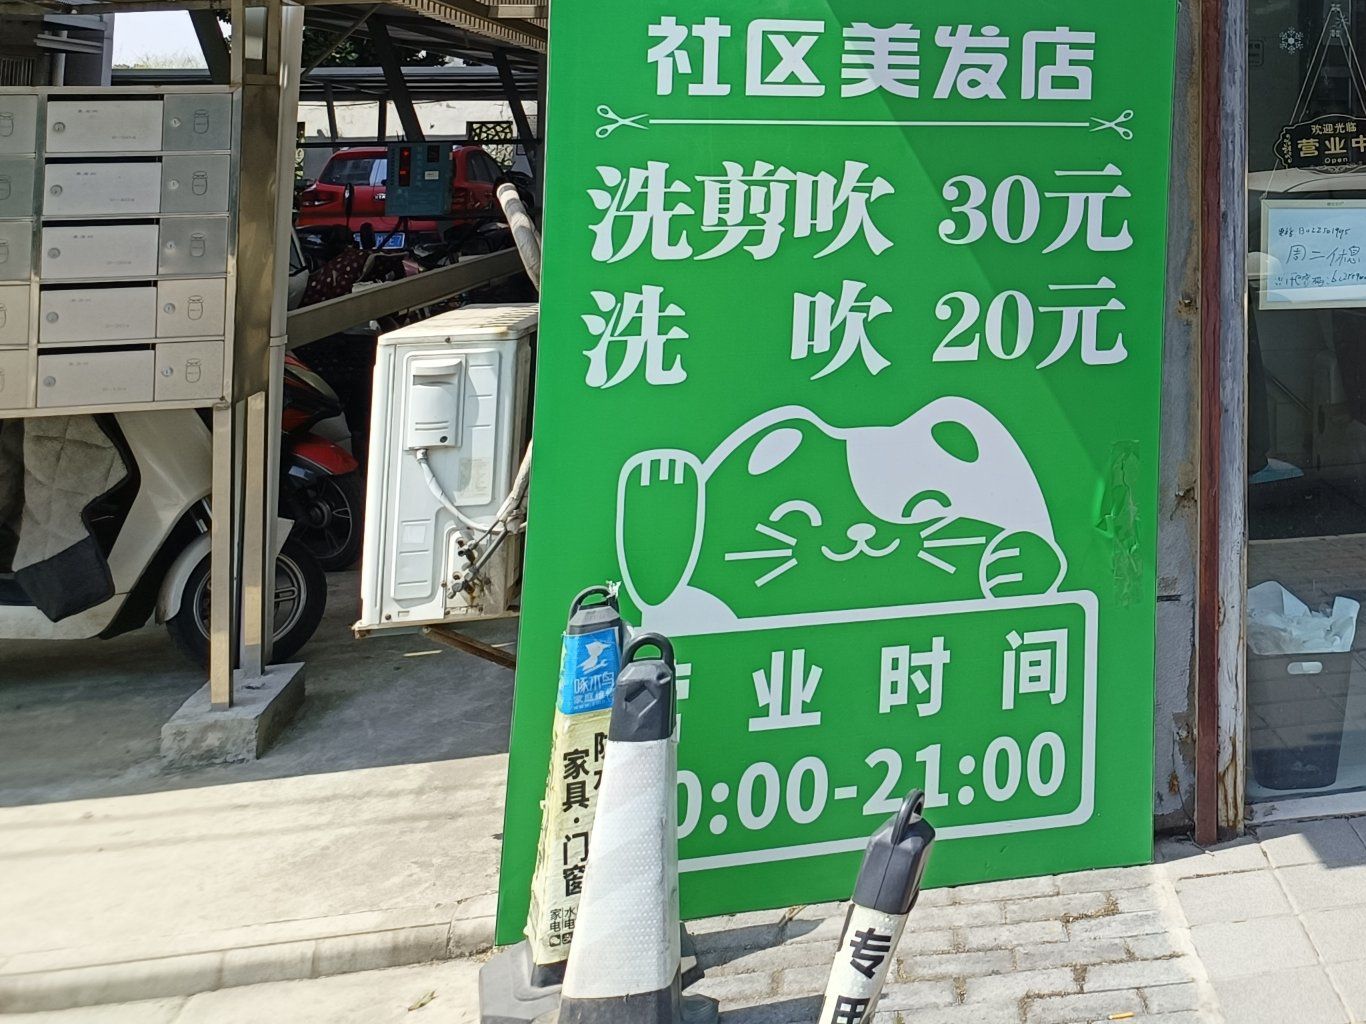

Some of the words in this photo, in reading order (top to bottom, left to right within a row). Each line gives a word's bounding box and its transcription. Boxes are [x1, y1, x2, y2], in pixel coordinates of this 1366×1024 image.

[647, 15, 1096, 100] 社区美发店
[1310, 122, 1357, 135] 欢迎光临
[586, 160, 894, 263] 洗剪吹
[938, 163, 1134, 254] 30元
[1286, 244, 1361, 267] 周二休息
[580, 284, 689, 389] 洗
[790, 279, 893, 381] 吹
[932, 276, 1128, 370] 20元
[676, 628, 1069, 743] 业时间
[677, 731, 1066, 840] 0:00-21:00
